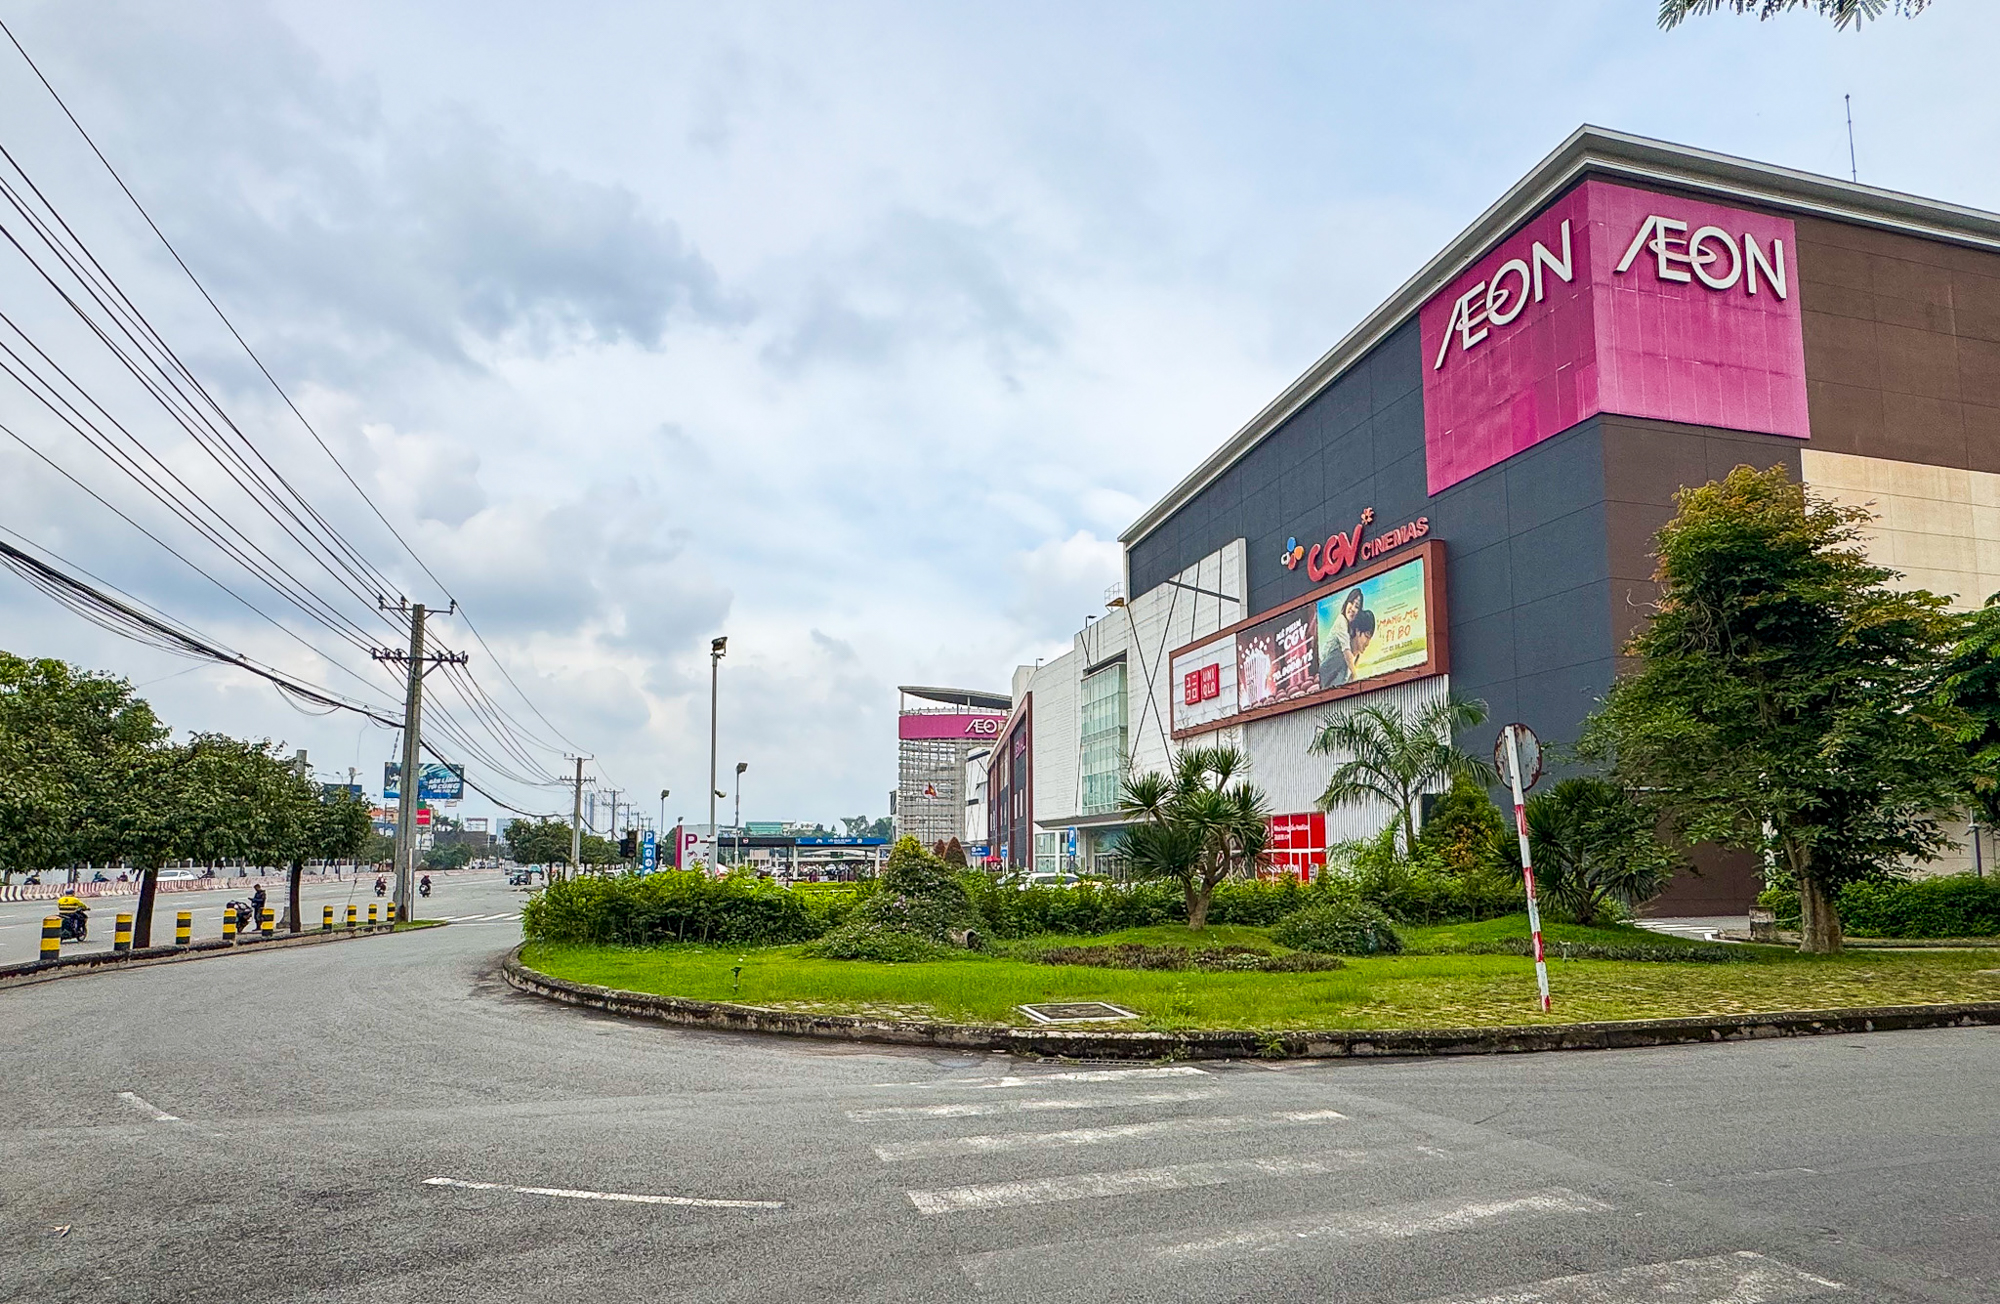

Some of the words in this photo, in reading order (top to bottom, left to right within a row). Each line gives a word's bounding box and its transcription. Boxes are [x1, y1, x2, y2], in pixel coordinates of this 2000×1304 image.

[1307, 523, 1363, 582] CGV
[1361, 517, 1430, 560] CINEMAS
[1202, 667, 1215, 682] UNI
[1202, 681, 1216, 698] QLO
[646, 832, 653, 843] P
[685, 833, 698, 851] P
